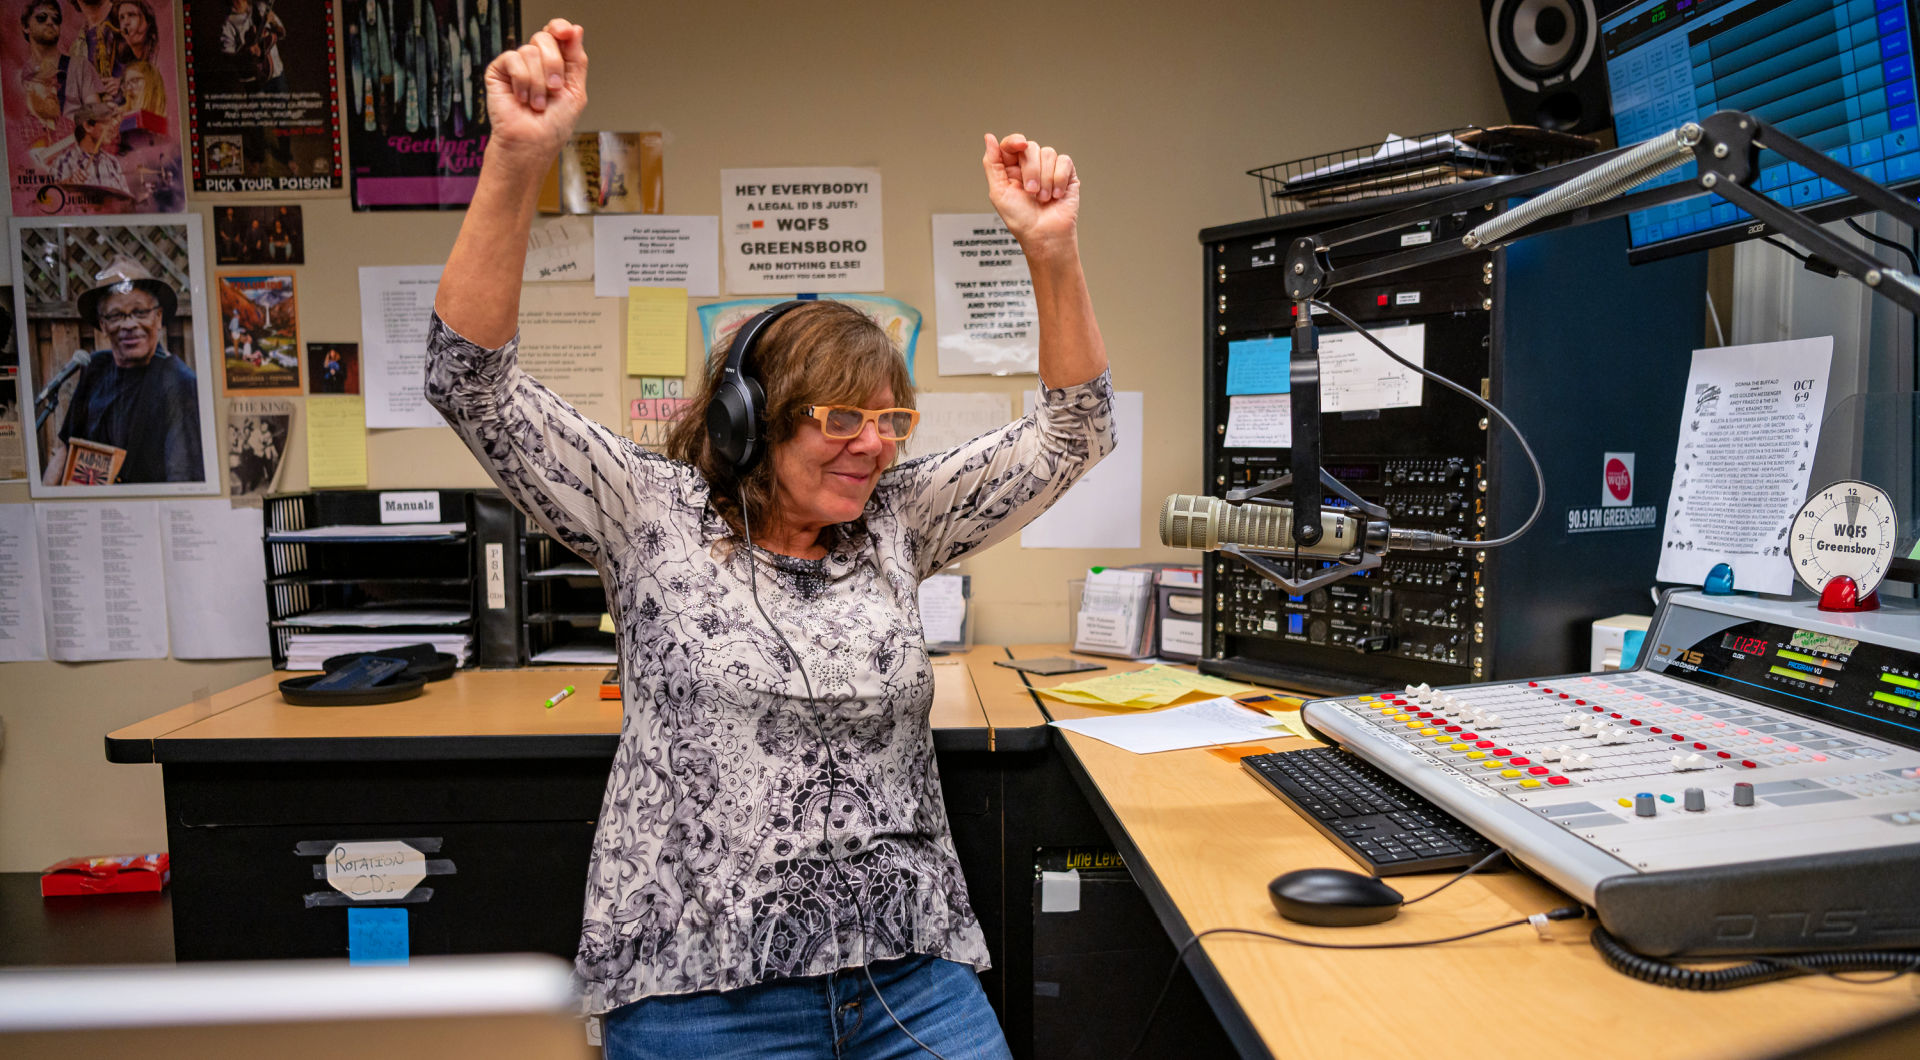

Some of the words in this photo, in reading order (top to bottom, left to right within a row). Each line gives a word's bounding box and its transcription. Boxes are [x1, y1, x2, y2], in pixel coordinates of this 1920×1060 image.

[388, 136, 476, 155] Getting
[438, 151, 484, 173] Kniv
[205, 179, 235, 191] PICK
[240, 179, 274, 191] YOUR
[280, 176, 332, 190] POISON
[735, 185, 767, 196] HEY
[772, 183, 868, 195] EVERYBODY!
[747, 203, 755, 211] A
[758, 202, 793, 211] LEGAL
[797, 202, 808, 210] ID
[812, 202, 822, 210] IS
[826, 201, 858, 209] JUST:
[777, 218, 829, 232] WQFS
[1748, 223, 1765, 234] acer
[741, 240, 867, 255] GREENSBORO
[749, 262, 772, 271] AND
[776, 261, 826, 270] NOTHING
[830, 261, 861, 269] ELSE!
[644, 384, 660, 396] NC
[668, 382, 677, 395] C
[1793, 380, 1815, 390] OCT
[1794, 392, 1810, 402] 6-9
[233, 402, 256, 412] THE
[260, 401, 290, 412] KING
[638, 403, 648, 416] B
[662, 403, 671, 417] B
[641, 424, 649, 442] A
[1608, 469, 1628, 491] wqfs
[385, 499, 434, 511] Manuals
[1568, 510, 1588, 528] 90.9
[1590, 509, 1602, 527] FM
[1604, 506, 1656, 526] GREENSBORO
[1834, 523, 1867, 538] WQFS
[1817, 540, 1876, 555] Greensboro
[1787, 661, 1814, 673] PROGRAM
[1067, 849, 1091, 868] Line
[351, 873, 395, 895] CD's
